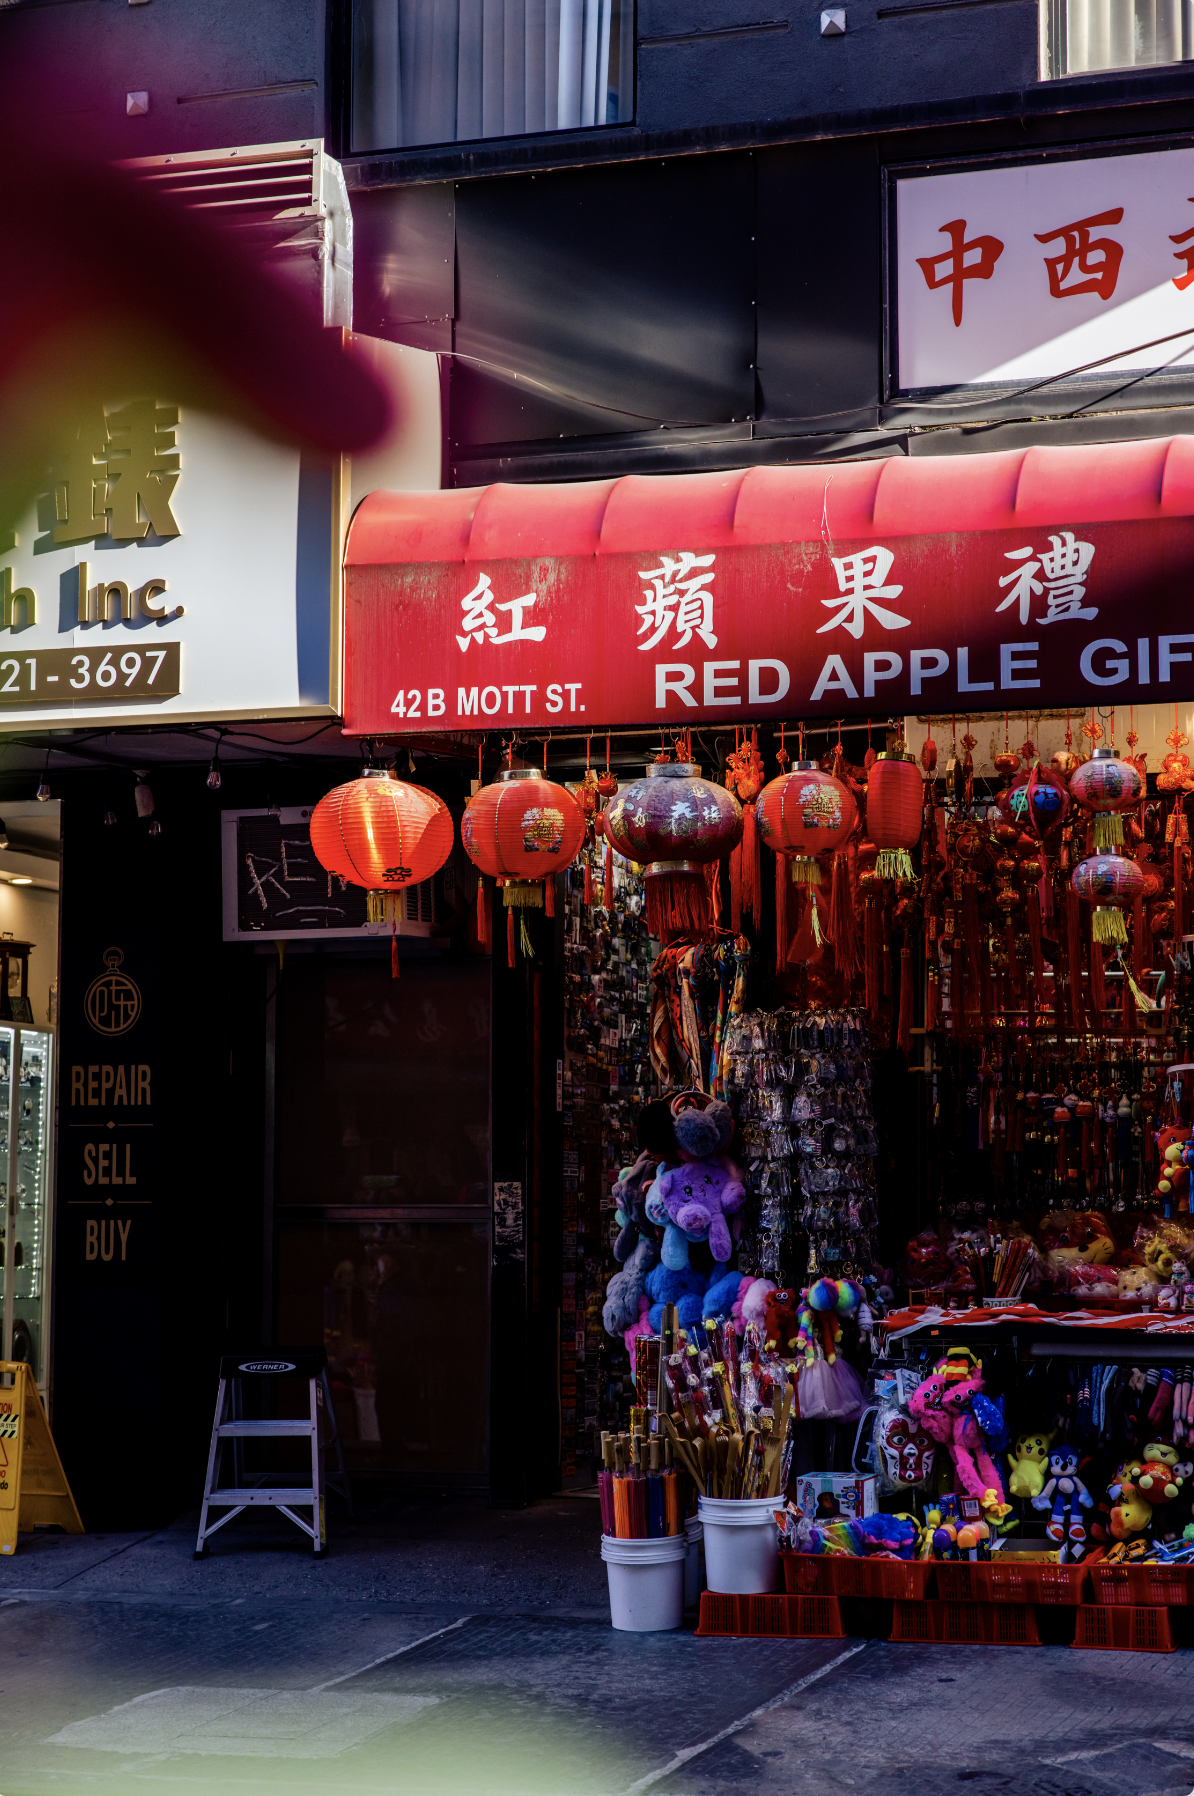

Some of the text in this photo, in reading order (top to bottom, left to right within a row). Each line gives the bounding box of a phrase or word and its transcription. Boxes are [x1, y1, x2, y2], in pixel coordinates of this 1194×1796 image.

[77, 561, 186, 622] Inc.
[455, 531, 1098, 653] 紅蘋果禮
[654, 633, 1194, 709] RED APPLE GIF
[457, 684, 538, 716] MOTT
[545, 682, 586, 713] ST.
[71, 1064, 152, 1106] REPAIR
[83, 1142, 137, 1186] SELL
[85, 1219, 132, 1262] BUY
